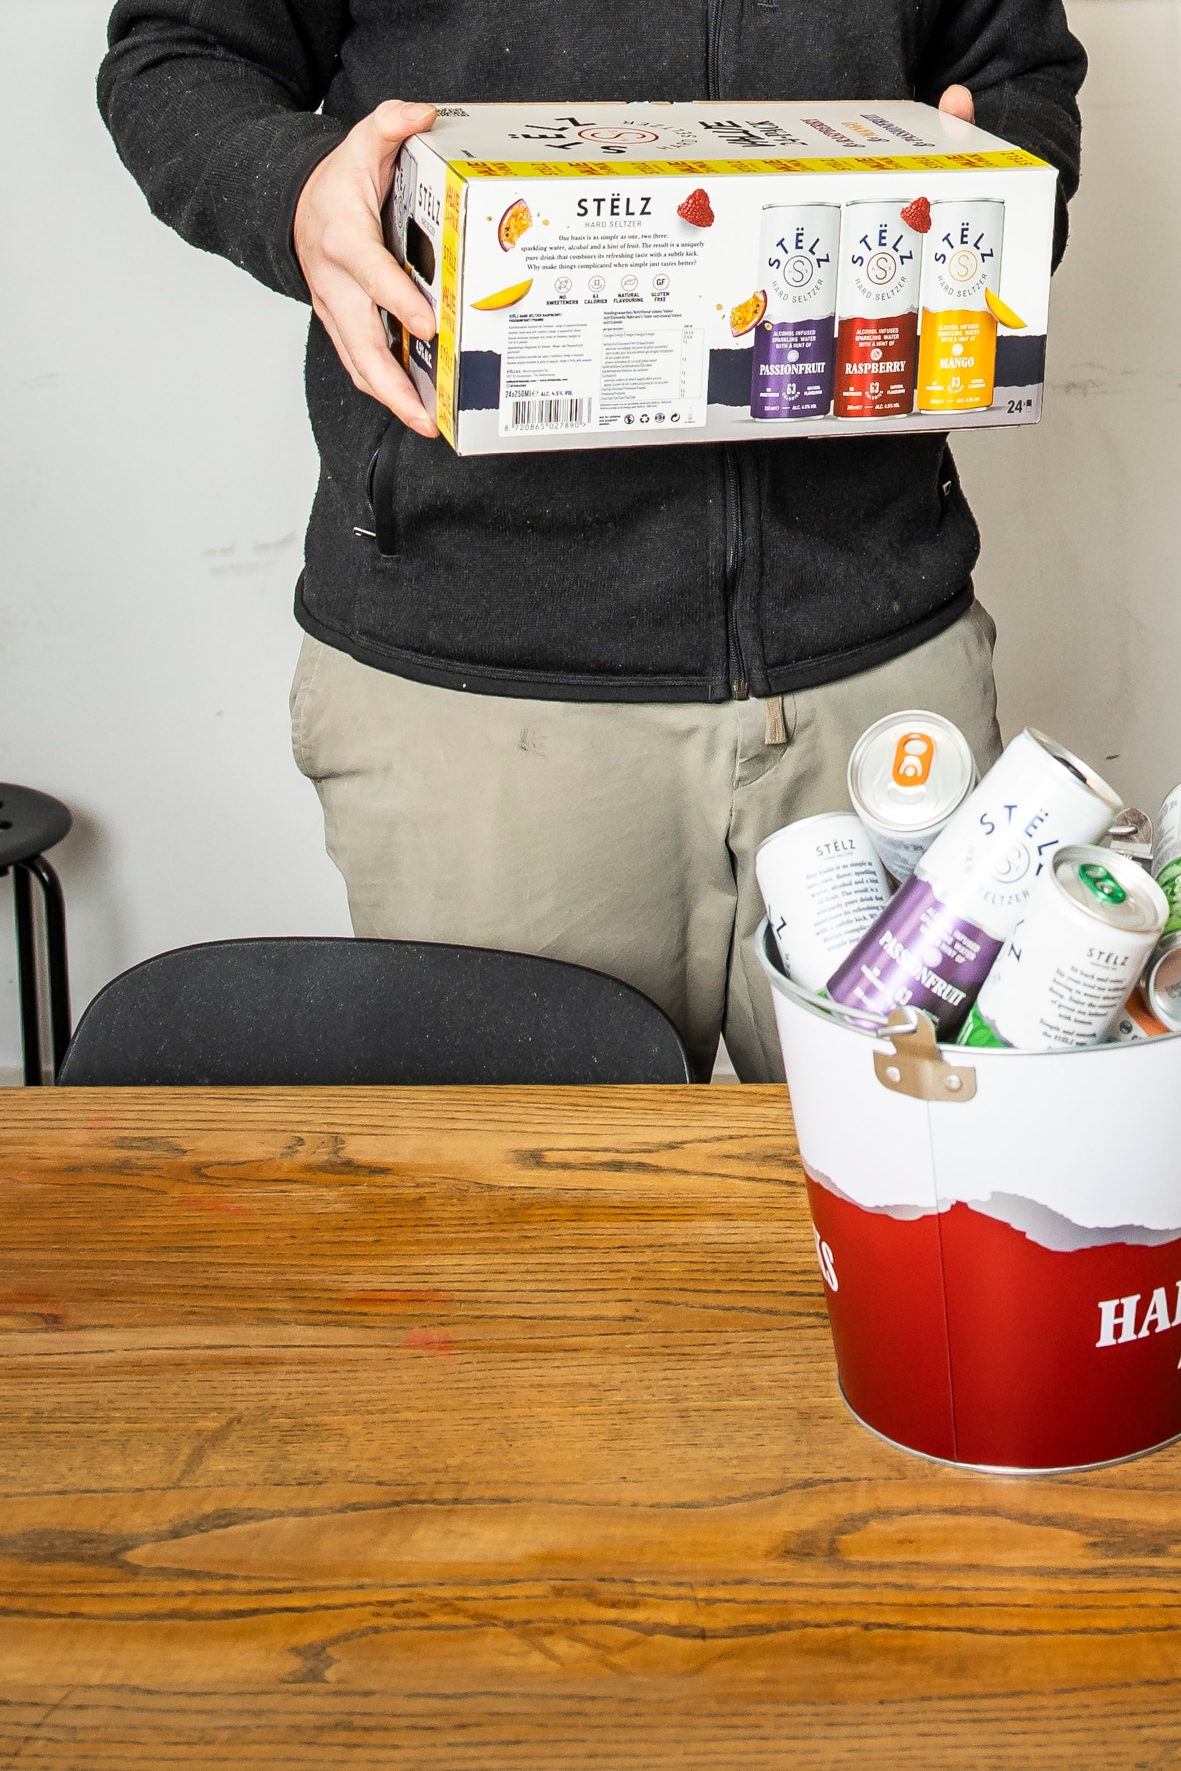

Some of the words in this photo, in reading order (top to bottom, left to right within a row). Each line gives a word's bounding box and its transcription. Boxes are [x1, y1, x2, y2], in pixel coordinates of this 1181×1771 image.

[507, 117, 628, 154] STËLZ
[418, 183, 441, 226] STËLZ
[577, 193, 651, 216] STËLZ
[609, 220, 642, 228] SELTZER
[768, 227, 830, 269] STËLZ
[852, 223, 913, 266] STËLZ
[935, 222, 994, 264] STËLZ
[772, 280, 788, 302] HARD
[792, 278, 824, 303] SELTZER
[855, 277, 871, 299] HARD
[875, 276, 907, 301] SELTZER
[937, 275, 954, 297] HARD
[957, 273, 988, 298] SELTZER
[760, 362, 826, 375] PASSIONFRUIT
[845, 360, 906, 374] RASPBERRY
[940, 356, 975, 369] MANGO
[786, 383, 796, 395] 63
[869, 382, 880, 393] 63
[951, 377, 961, 388] 63
[816, 840, 856, 856] STËLZ
[1087, 948, 1129, 966] STËLZ
